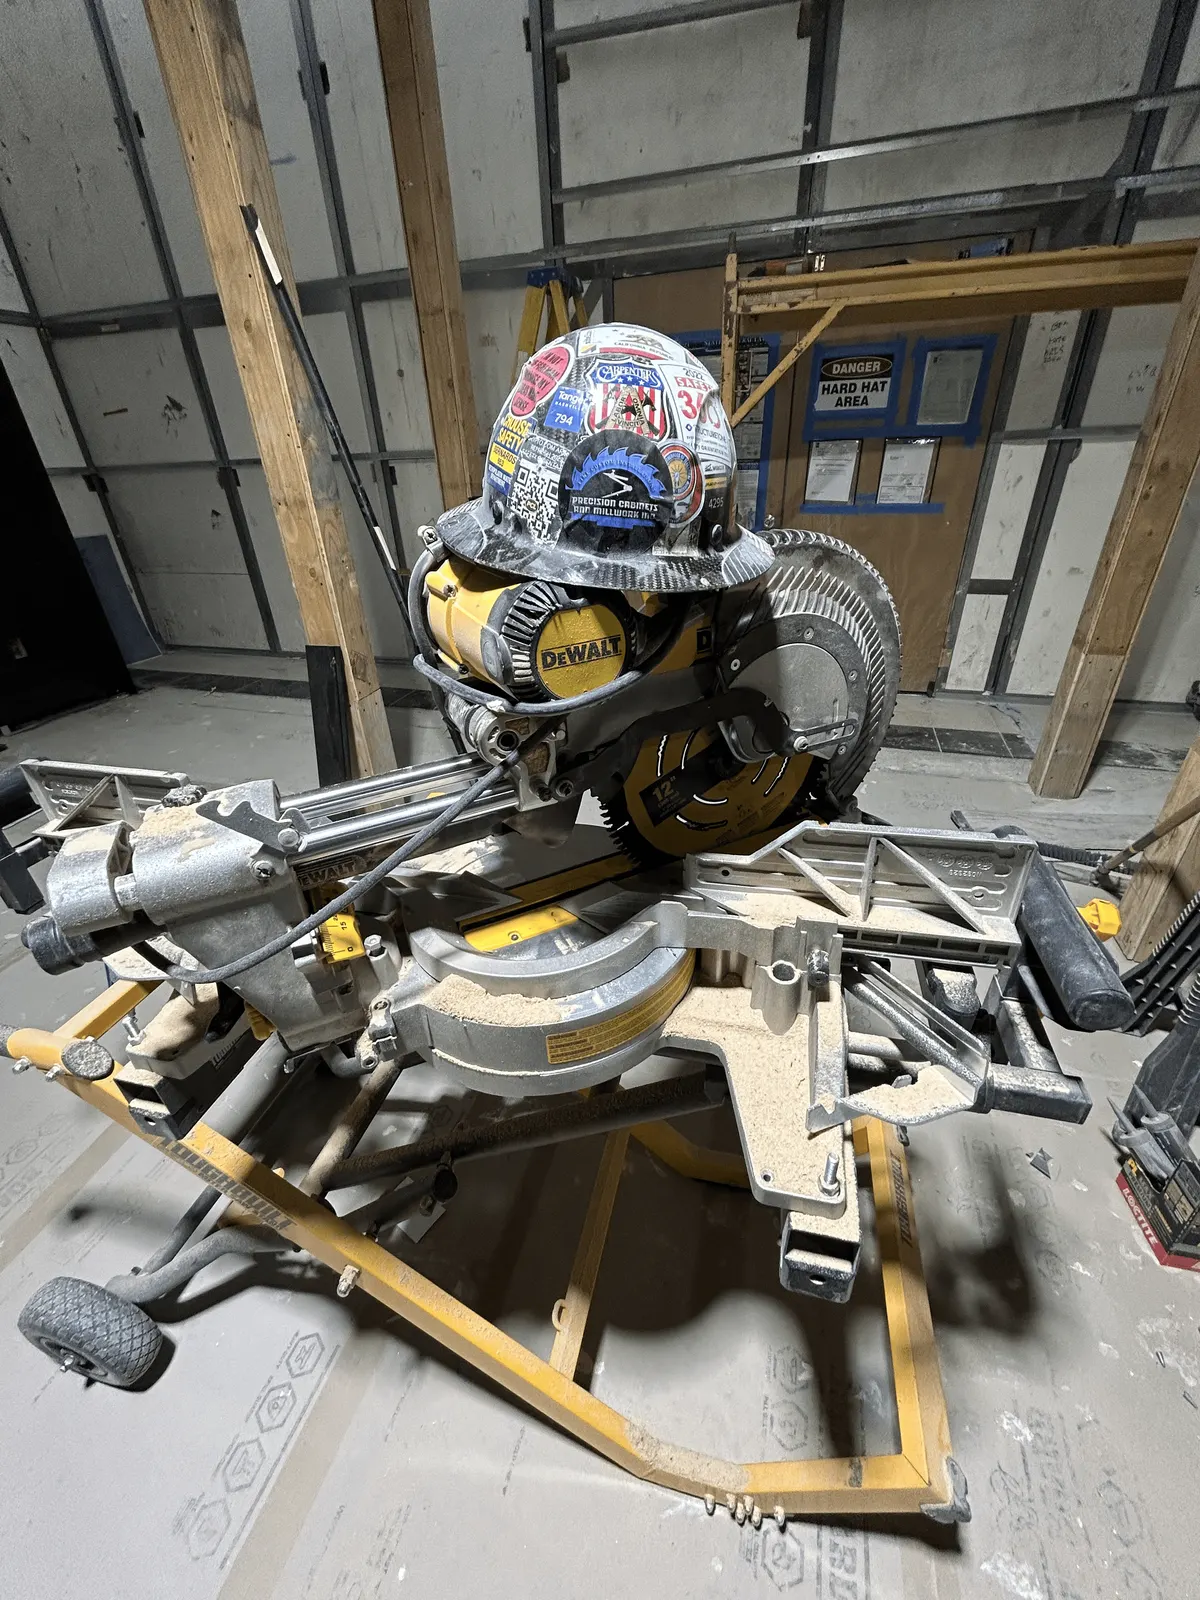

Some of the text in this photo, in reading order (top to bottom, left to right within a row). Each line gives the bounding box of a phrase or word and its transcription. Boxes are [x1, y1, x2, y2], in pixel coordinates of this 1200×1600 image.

[832, 360, 881, 375] DANGER
[597, 363, 661, 388] CARPENTERS
[821, 380, 888, 395] HARD HAT
[834, 395, 869, 407] AREA
[554, 413, 574, 425] 794
[498, 427, 525, 453] SAFETY
[571, 496, 658, 512] PRECISION CABINETS
[708, 497, 724, 509] 4295
[573, 505, 591, 514] AND
[593, 506, 639, 519] MILLWORK
[302, 860, 357, 886] EWALT
[339, 921, 348, 931] 15
[889, 1149, 914, 1249] TOUGHBUILT
[1122, 1187, 1158, 1245] LOCTITE
